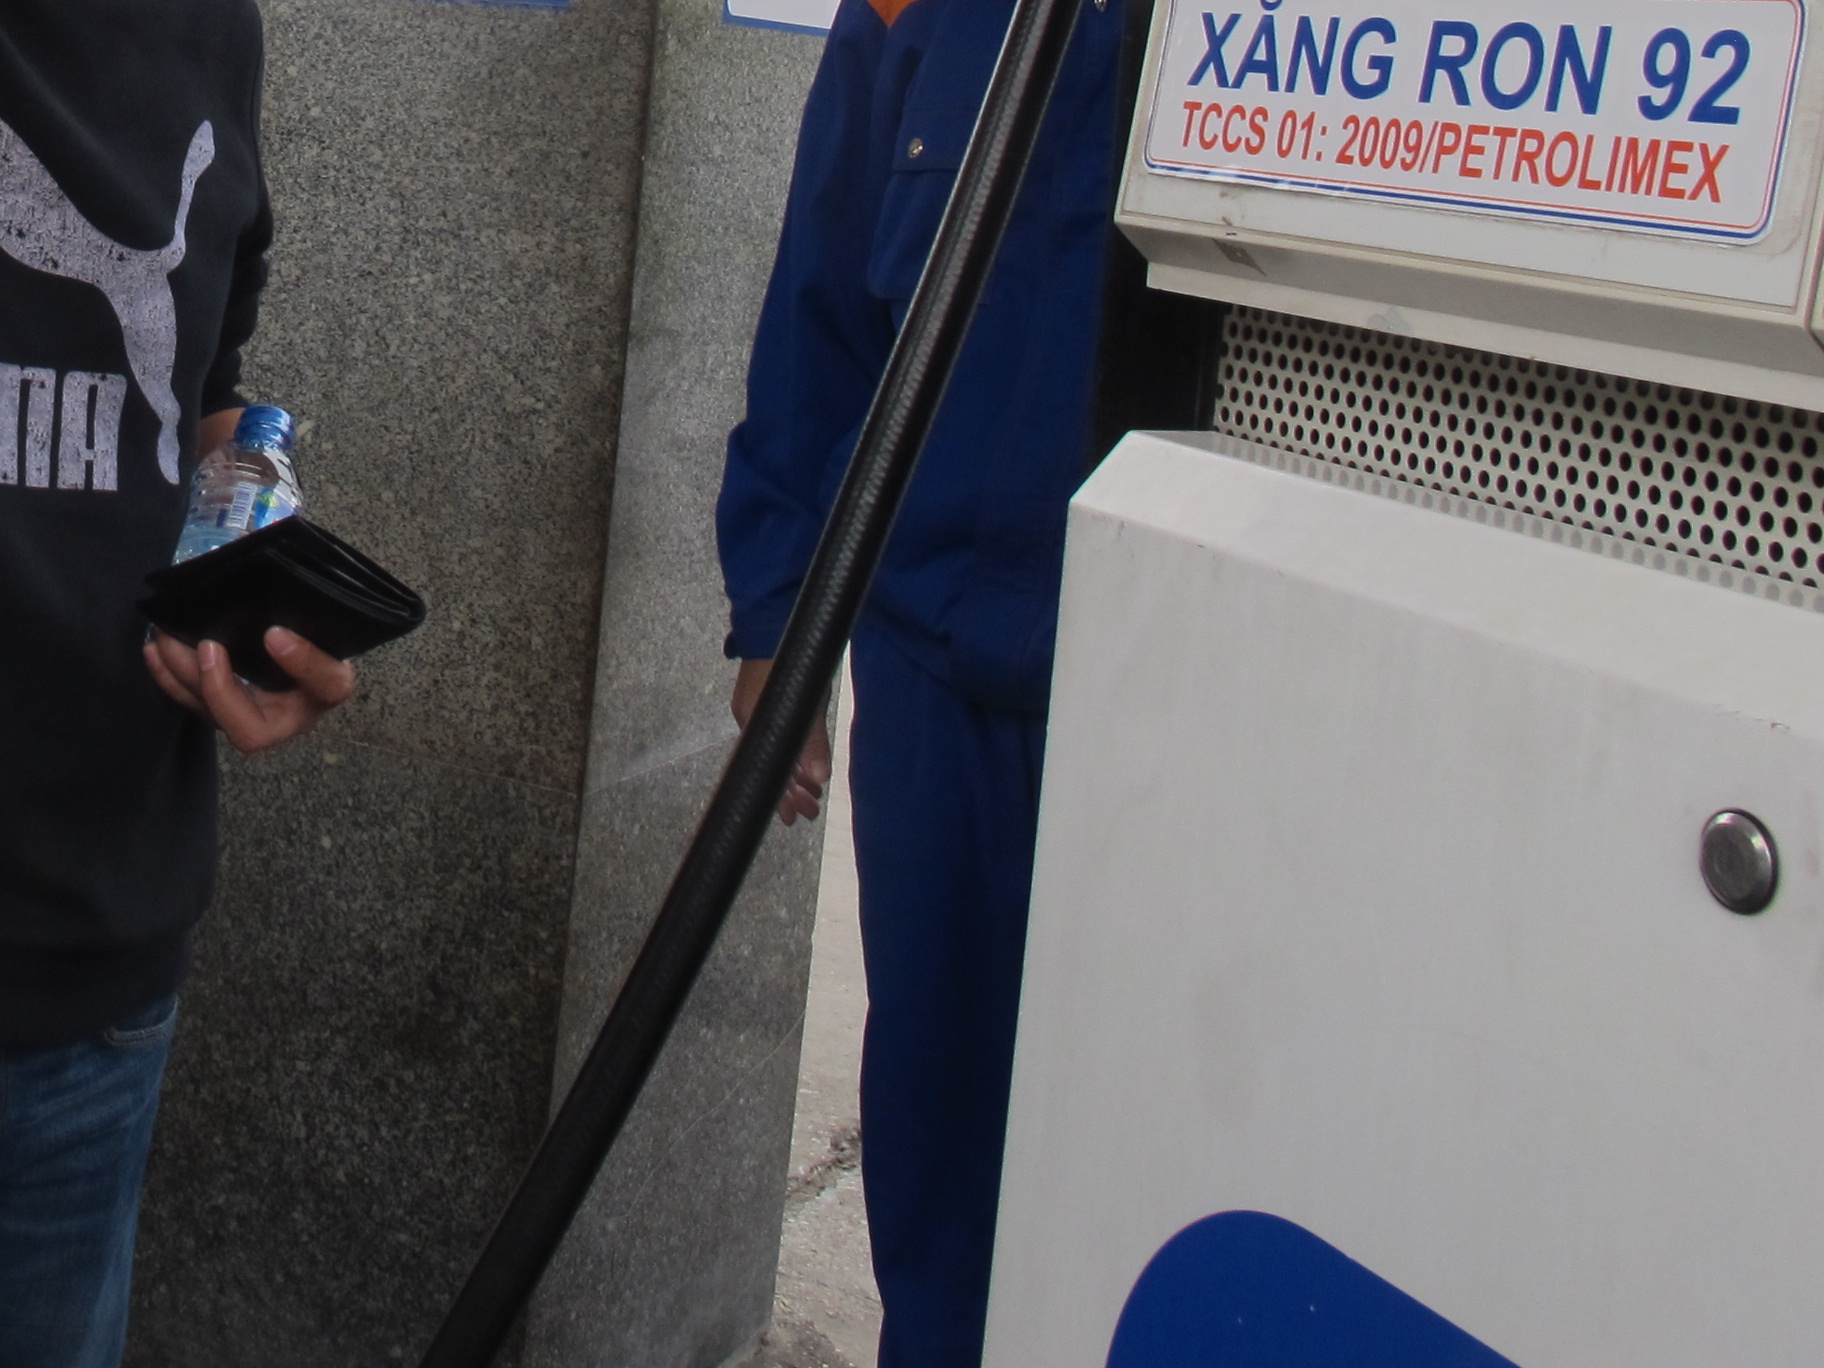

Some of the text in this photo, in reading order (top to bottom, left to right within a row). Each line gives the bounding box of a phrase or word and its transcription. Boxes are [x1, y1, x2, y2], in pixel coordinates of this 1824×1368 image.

[1417, 19, 1613, 116] RON
[1637, 26, 1751, 125] 92
[1181, 100, 1731, 204] TCCS 01: 2009/PETROLIMEX
